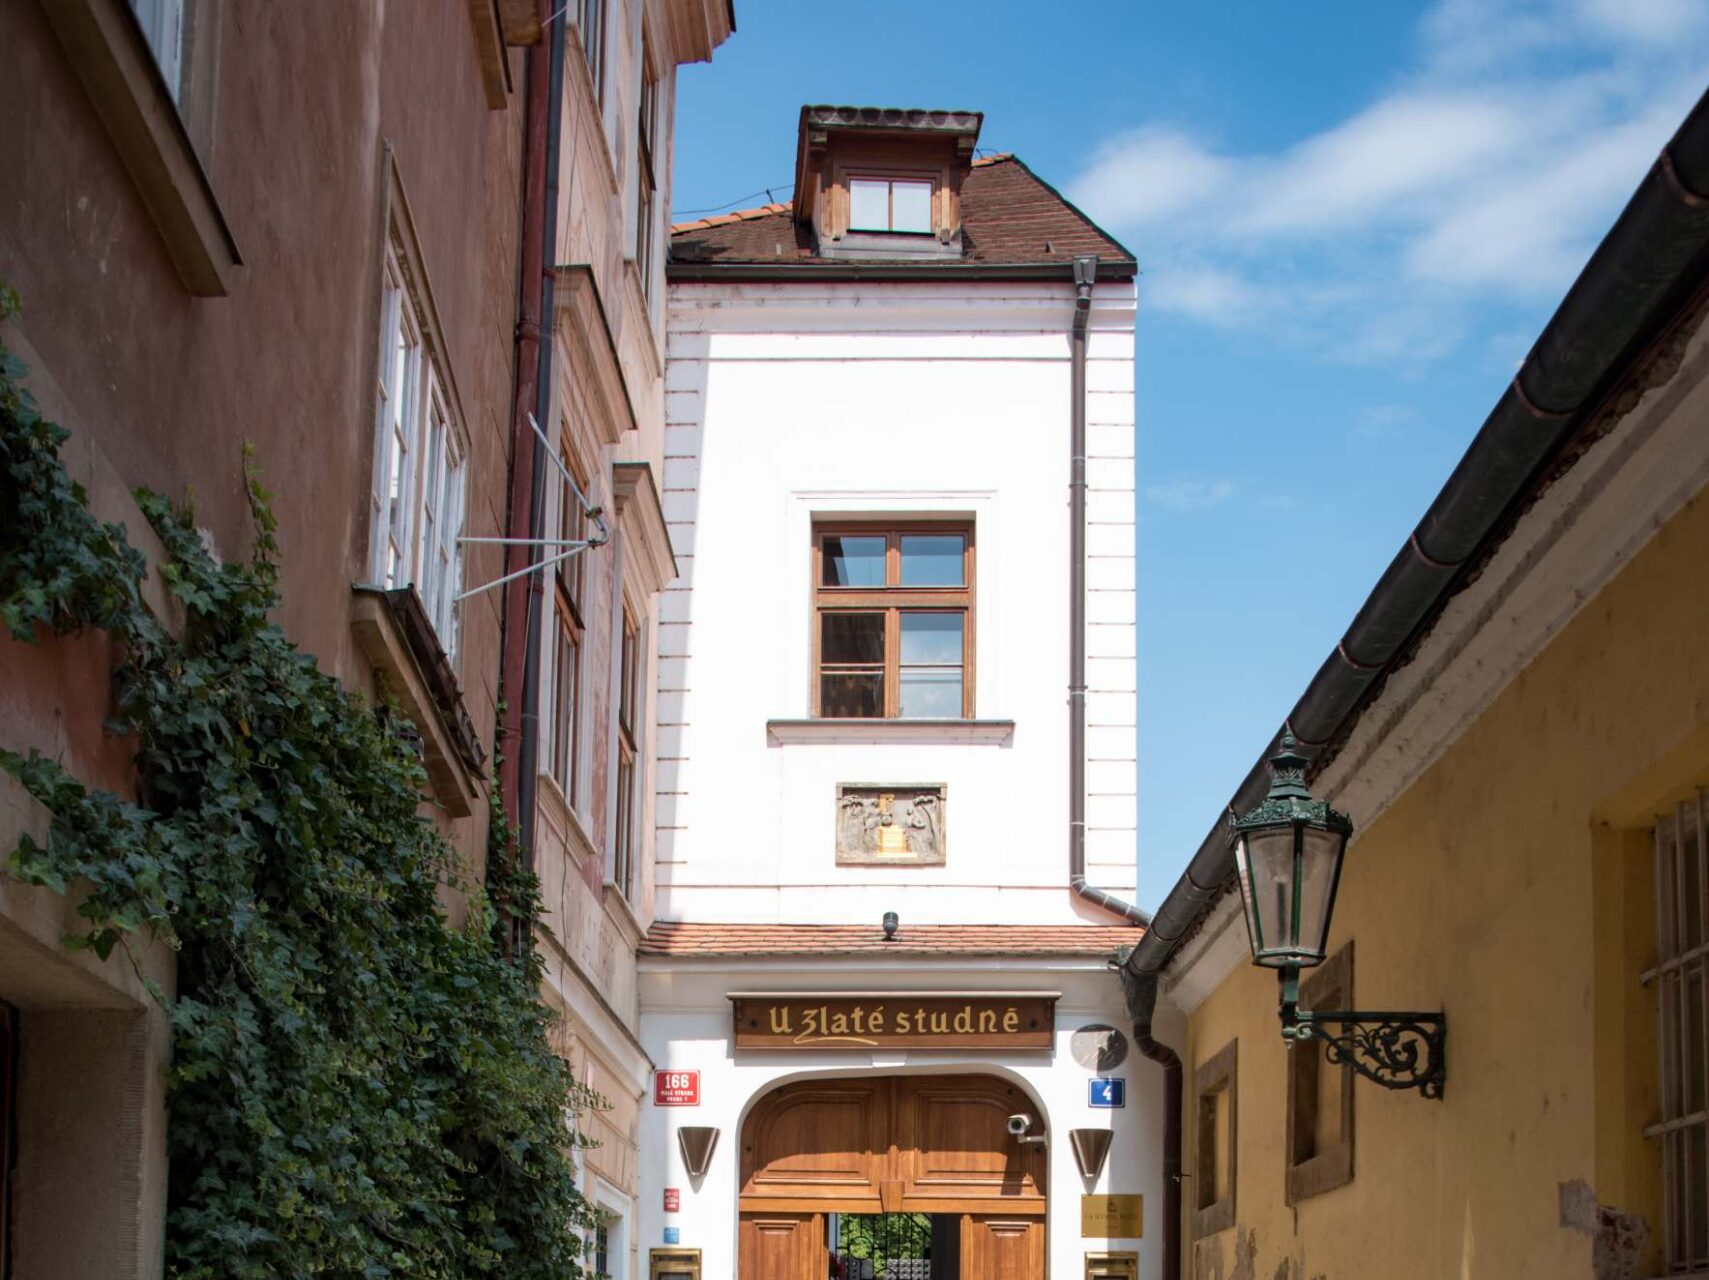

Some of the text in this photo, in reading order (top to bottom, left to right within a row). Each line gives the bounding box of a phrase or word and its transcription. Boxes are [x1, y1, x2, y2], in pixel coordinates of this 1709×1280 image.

[769, 1006, 793, 1034] U
[665, 1074, 689, 1089] 166
[1102, 1085, 1112, 1101] 4
